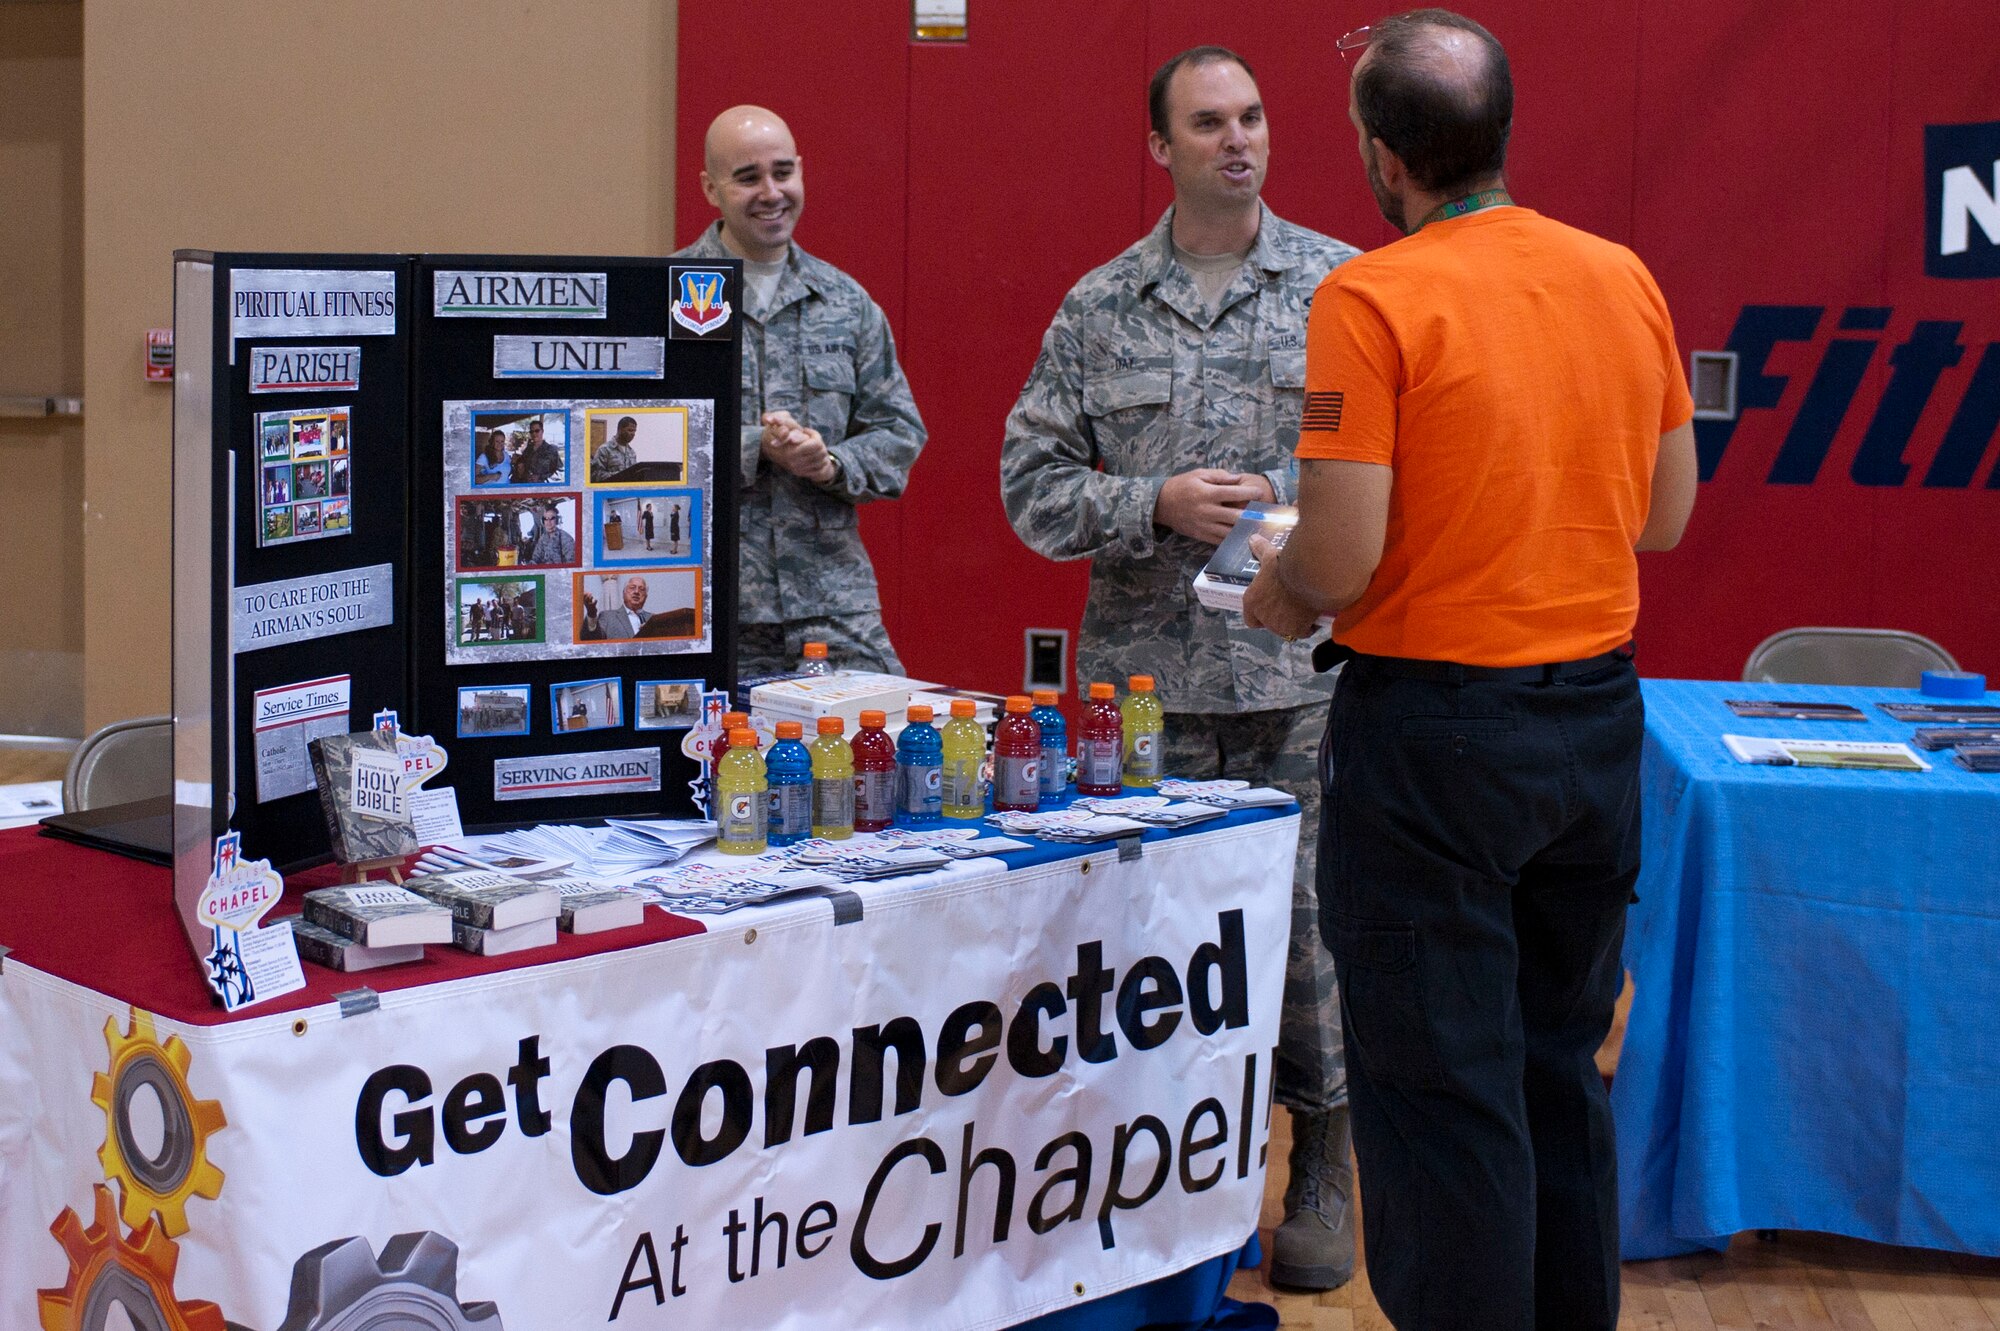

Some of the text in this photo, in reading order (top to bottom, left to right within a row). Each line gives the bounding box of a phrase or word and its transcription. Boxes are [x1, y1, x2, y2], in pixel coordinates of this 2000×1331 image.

[323, 291, 395, 317] FITNESS
[444, 276, 600, 307] AIRMEN
[261, 352, 351, 384] PARISH
[531, 340, 627, 371] UNIT
[1114, 356, 1135, 371] DAY
[244, 577, 371, 614] TO CARE FOR THE
[250, 603, 365, 639] AIRMAN'S SOUL
[262, 691, 340, 717] Service Times
[404, 757, 434, 772] PEL
[501, 761, 650, 786] SERVING AIRMEN
[358, 768, 400, 795] HOLY
[357, 789, 402, 814] BIBLE
[211, 867, 259, 889] NELLIS
[453, 874, 513, 886] HOLY
[208, 885, 270, 916] CHAPEL
[355, 891, 410, 902] HOLY
[355, 908, 1250, 1196] Get Connected
[607, 1224, 689, 1322] At
[722, 1196, 838, 1284] the
